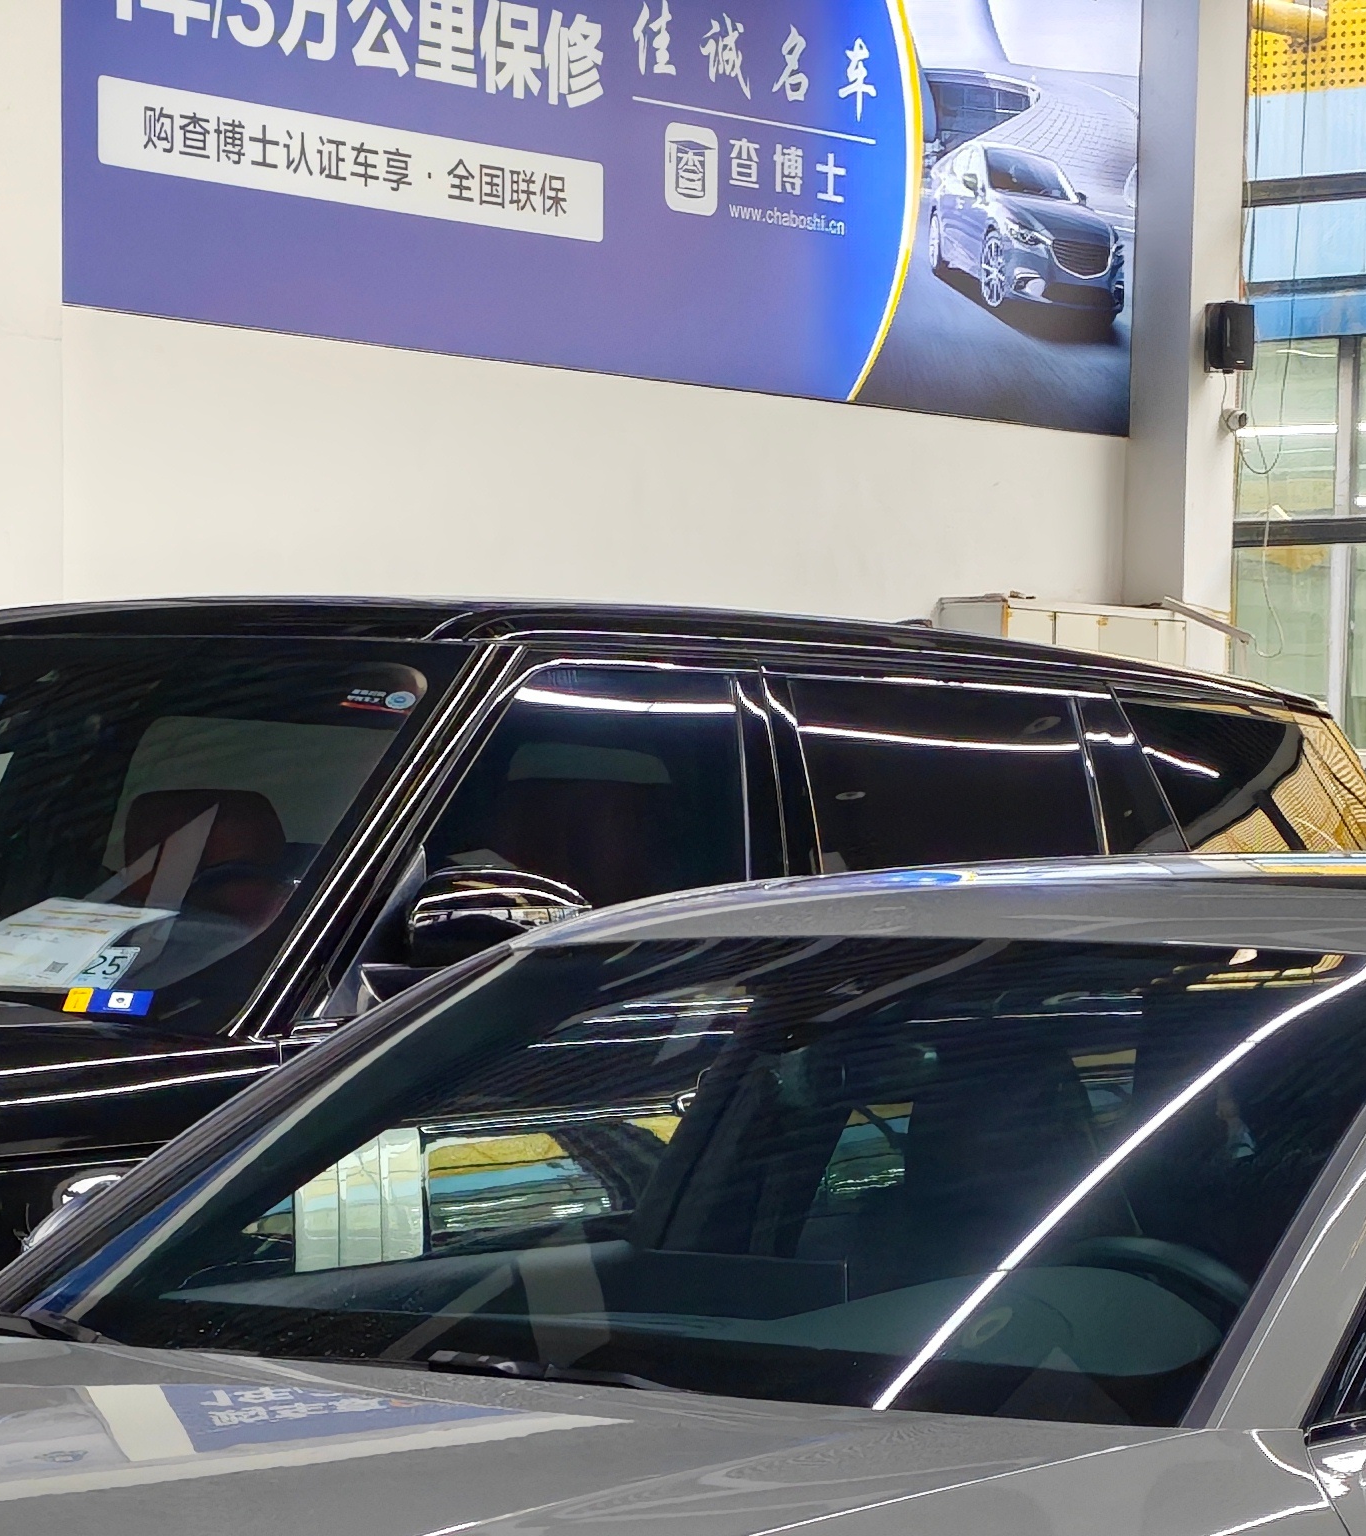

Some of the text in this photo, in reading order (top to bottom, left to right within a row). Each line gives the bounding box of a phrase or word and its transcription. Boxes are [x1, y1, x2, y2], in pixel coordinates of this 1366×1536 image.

[632, 0, 877, 122] 佳诚名车
[729, 137, 847, 204] 查博士
[729, 202, 845, 236] www.chaboshi.cn
